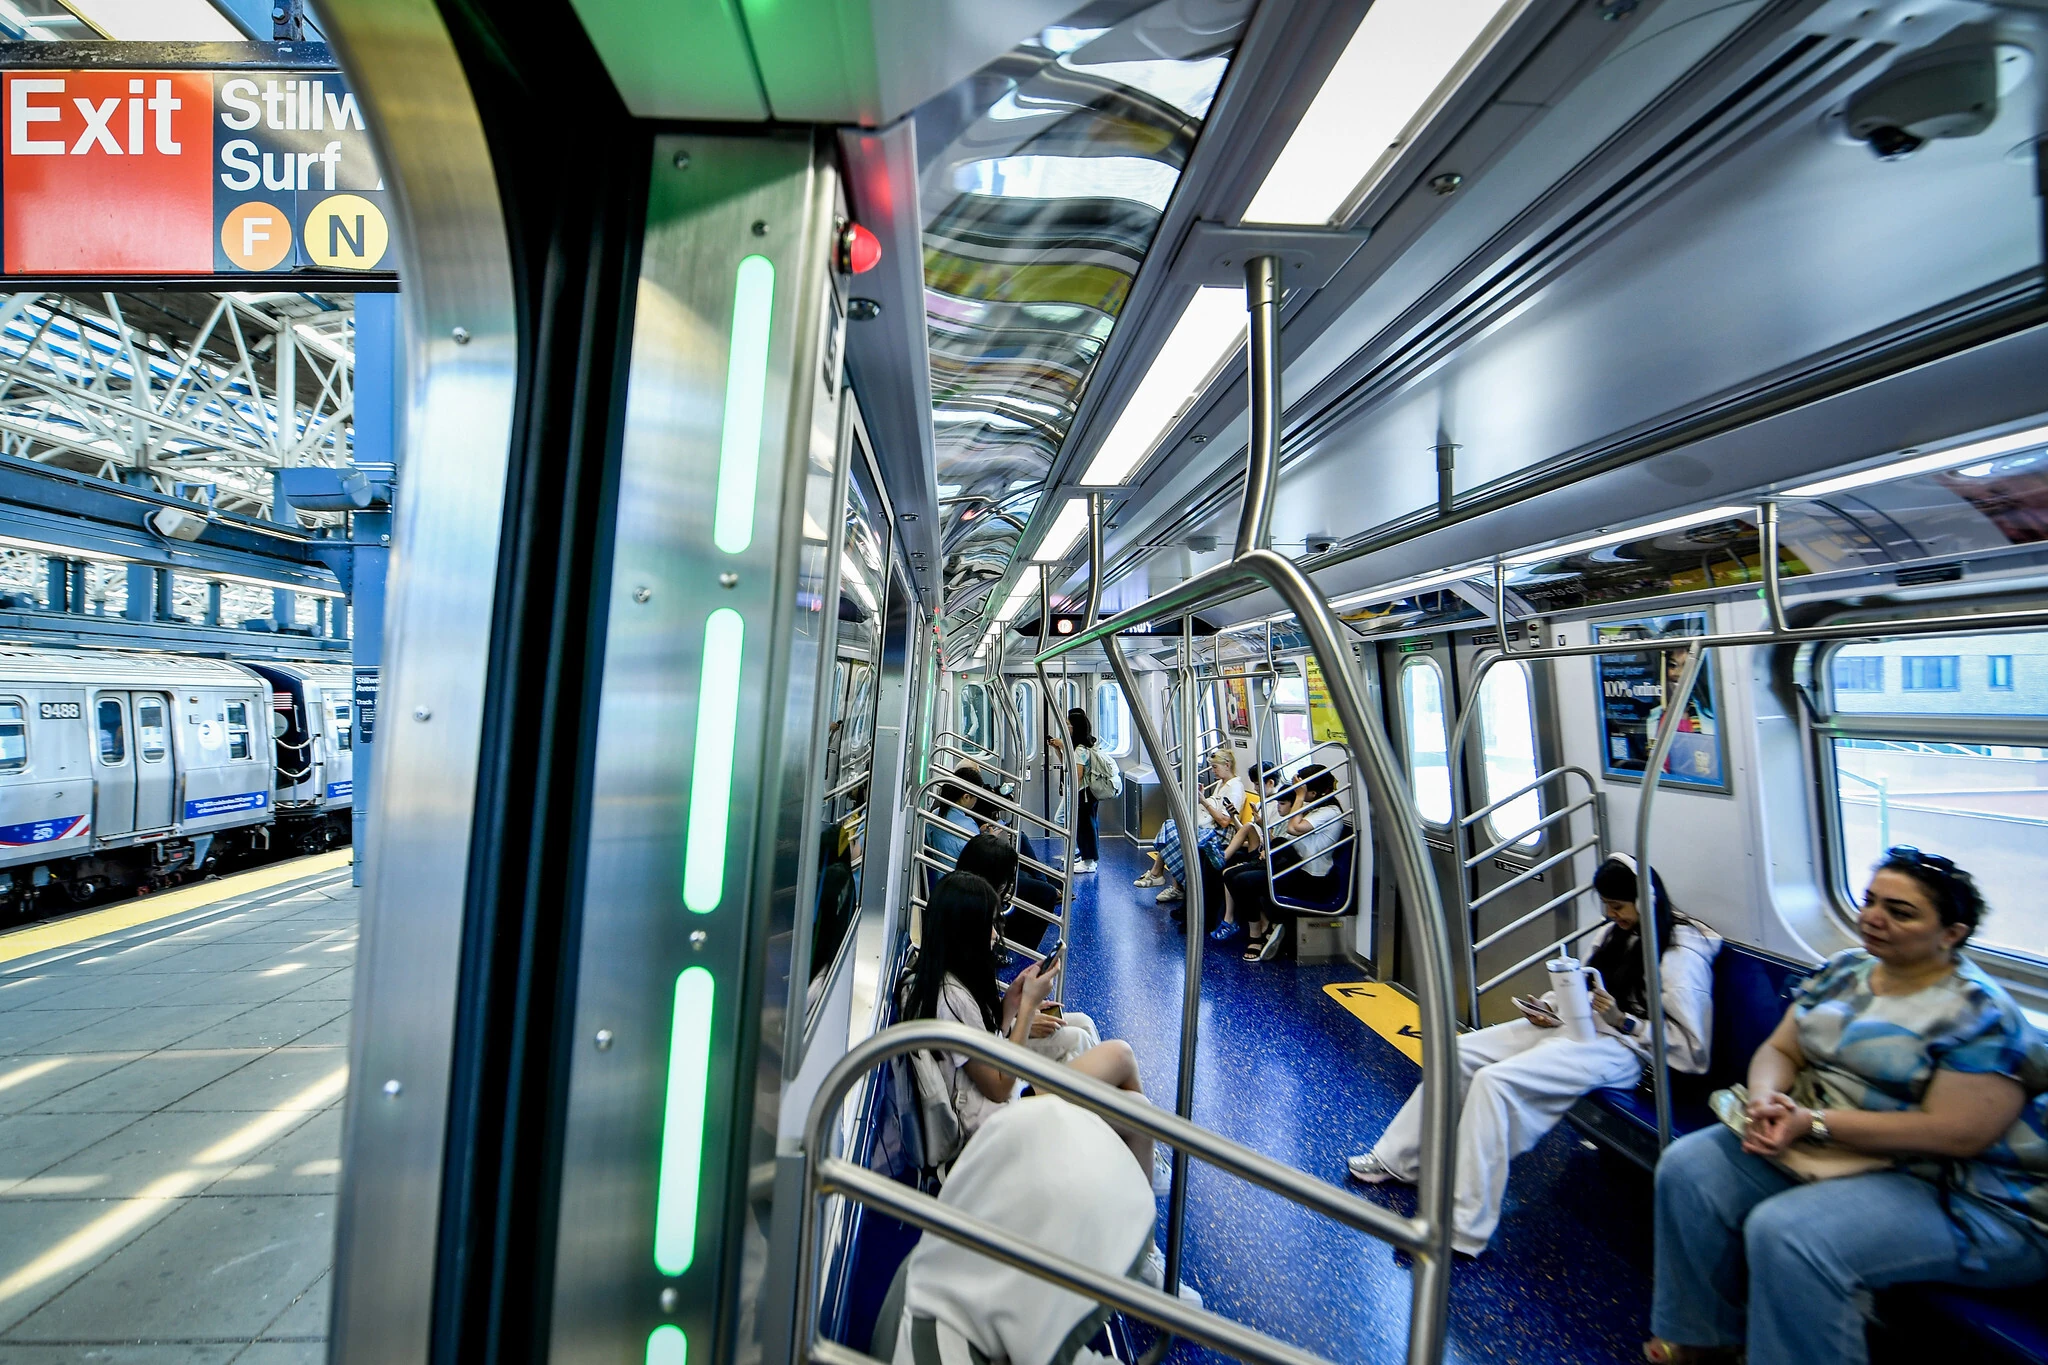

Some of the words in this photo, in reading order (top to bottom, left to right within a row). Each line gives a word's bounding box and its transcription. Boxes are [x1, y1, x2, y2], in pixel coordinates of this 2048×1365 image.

[10, 79, 182, 156] Exit
[220, 139, 342, 191] Surf
[243, 217, 272, 256] F
[329, 215, 365, 257] N
[1603, 680, 1633, 698] 100%
[41, 703, 79, 718] 9488
